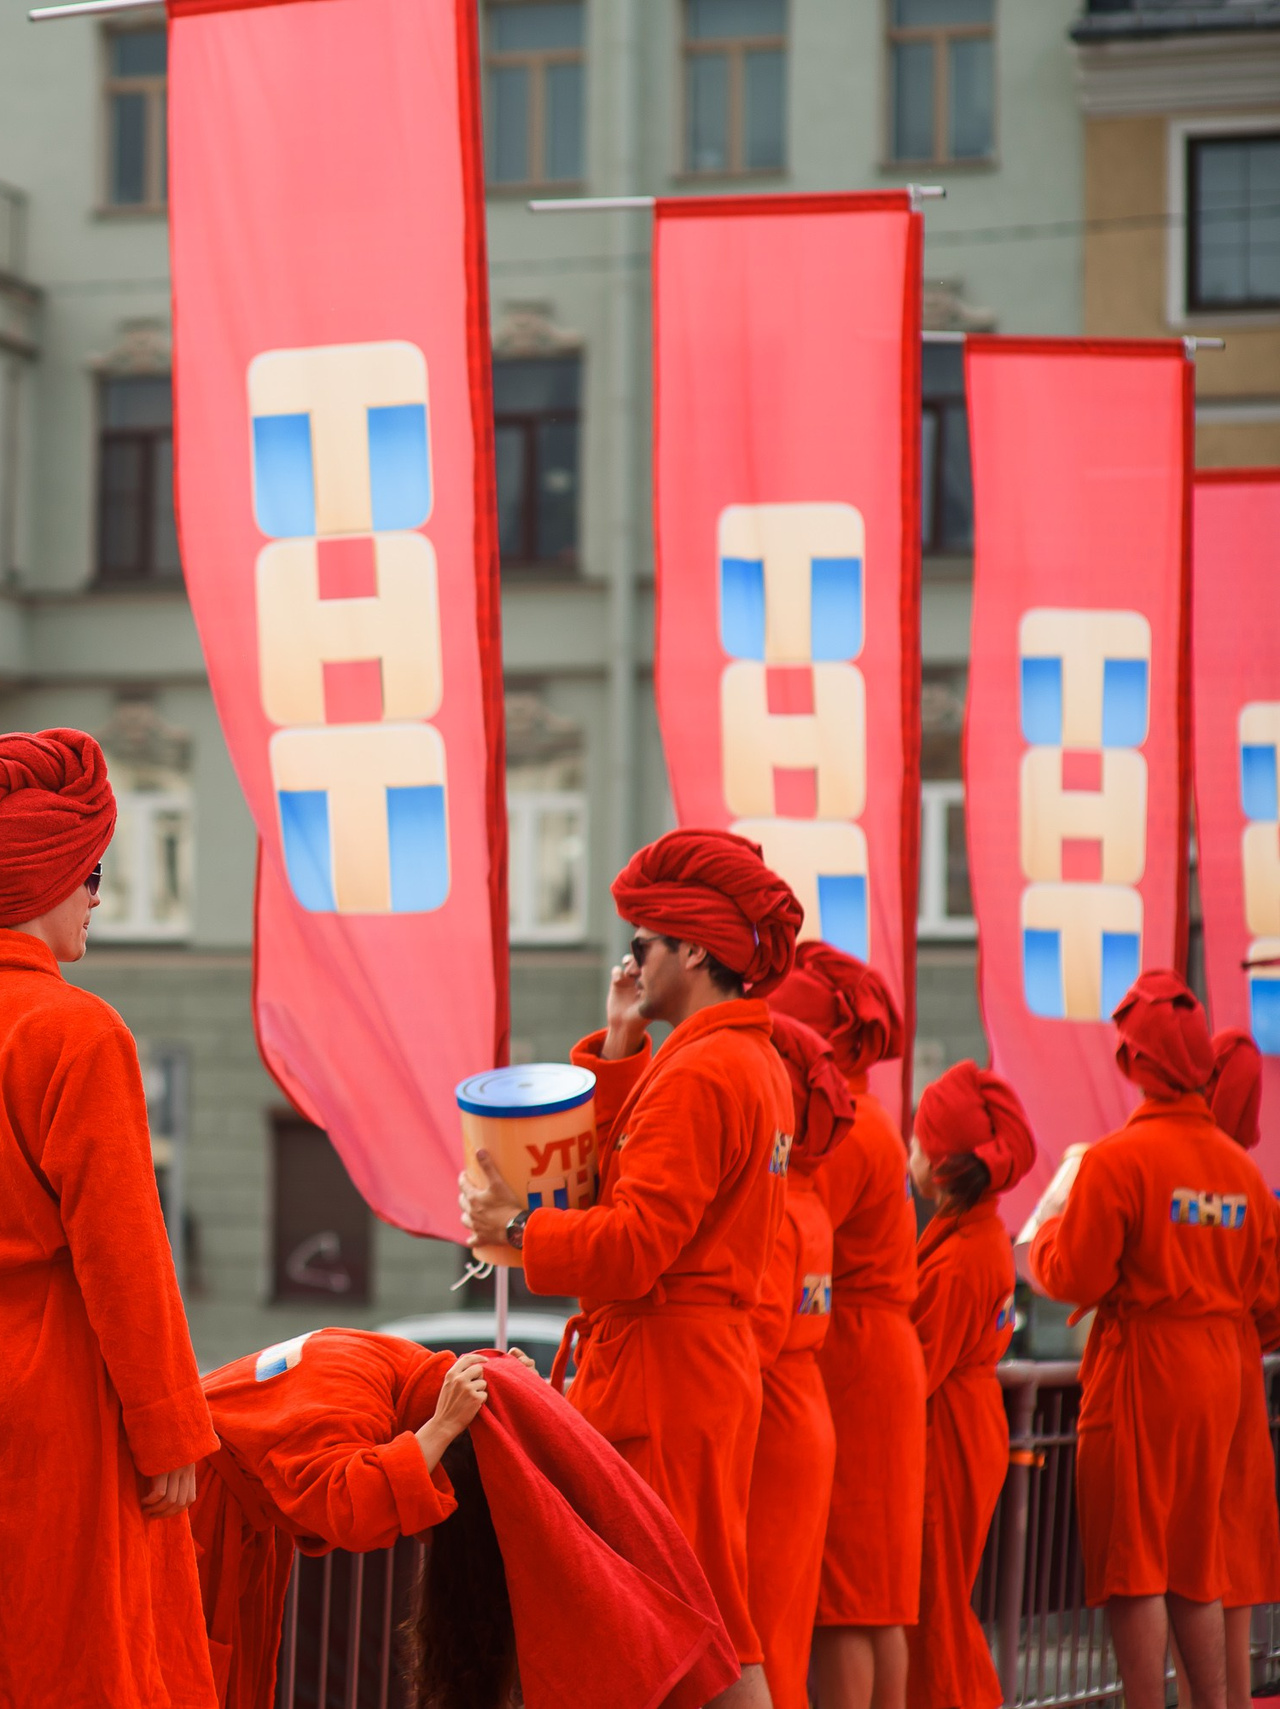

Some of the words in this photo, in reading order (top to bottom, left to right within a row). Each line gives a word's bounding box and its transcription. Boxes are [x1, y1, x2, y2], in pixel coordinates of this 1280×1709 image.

[247, 340, 450, 914] ТНТ
[1019, 607, 1151, 1021] ТНТ
[1170, 1187, 1248, 1229] ТНТ
